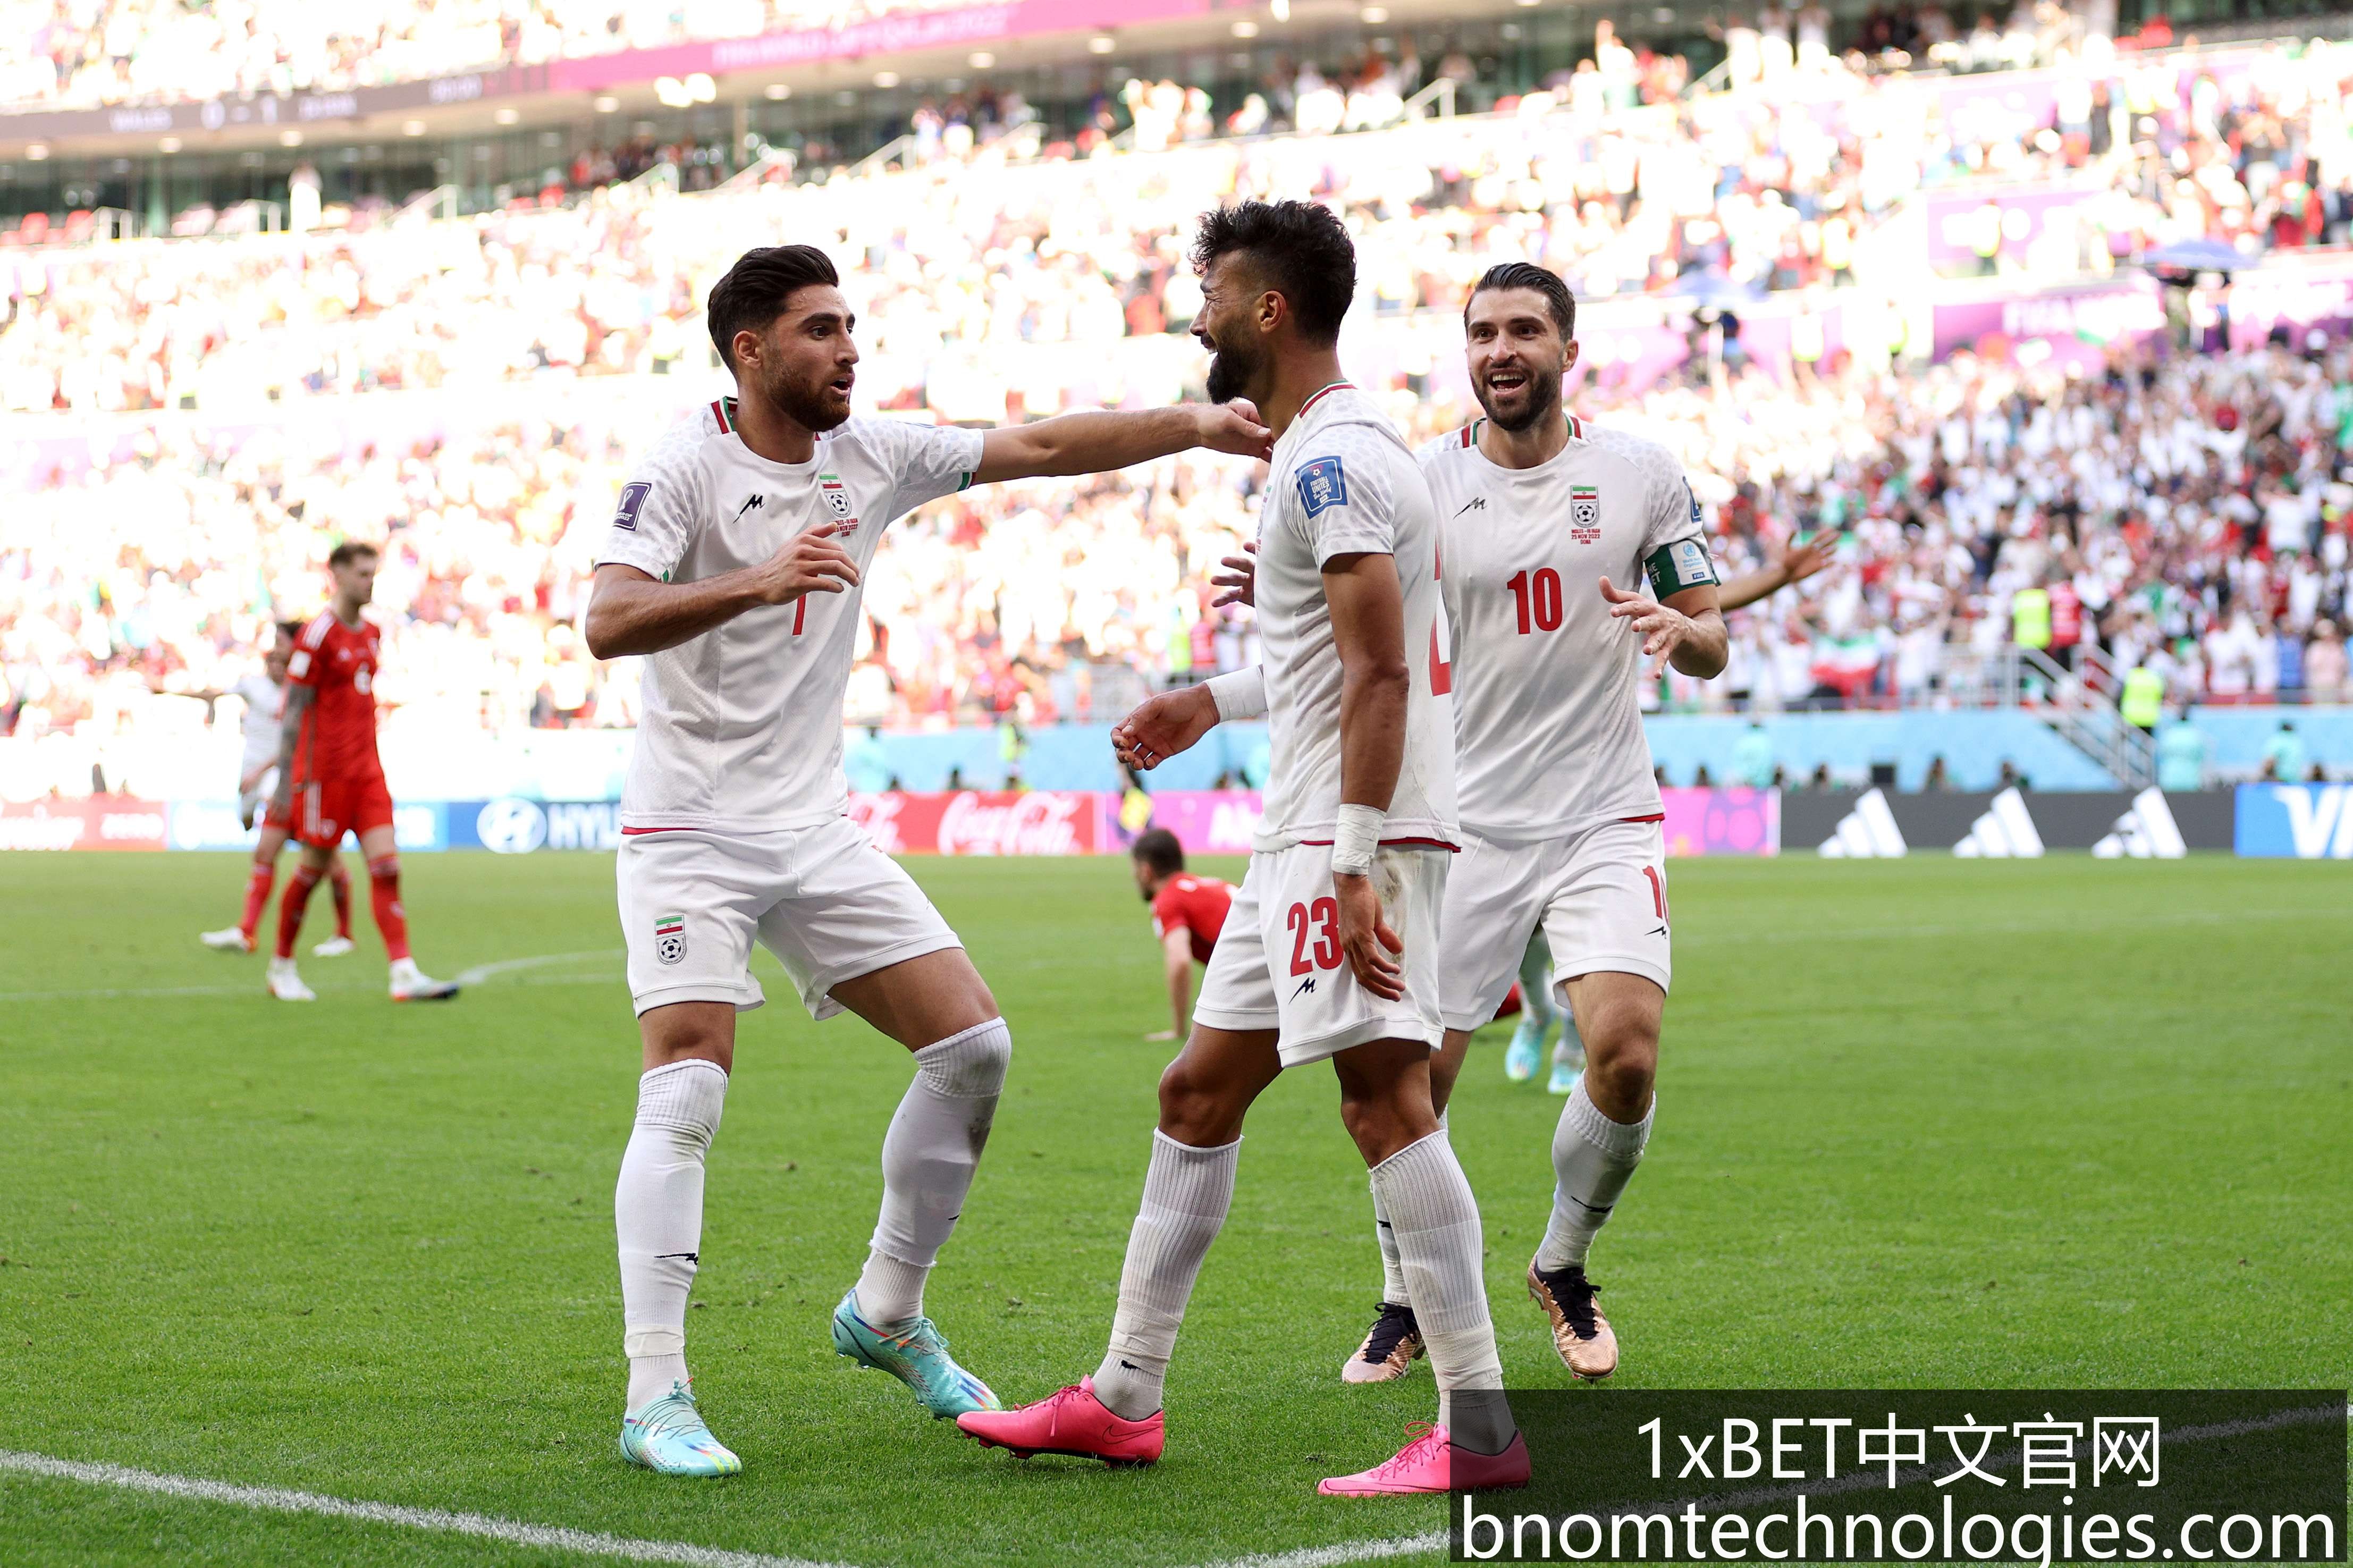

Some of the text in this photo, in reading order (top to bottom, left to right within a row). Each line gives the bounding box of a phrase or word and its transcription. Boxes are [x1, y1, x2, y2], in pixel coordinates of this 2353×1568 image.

[1312, 480, 1330, 493] UNITES
[1507, 567, 1563, 635] 10
[1287, 896, 1344, 977] 23
